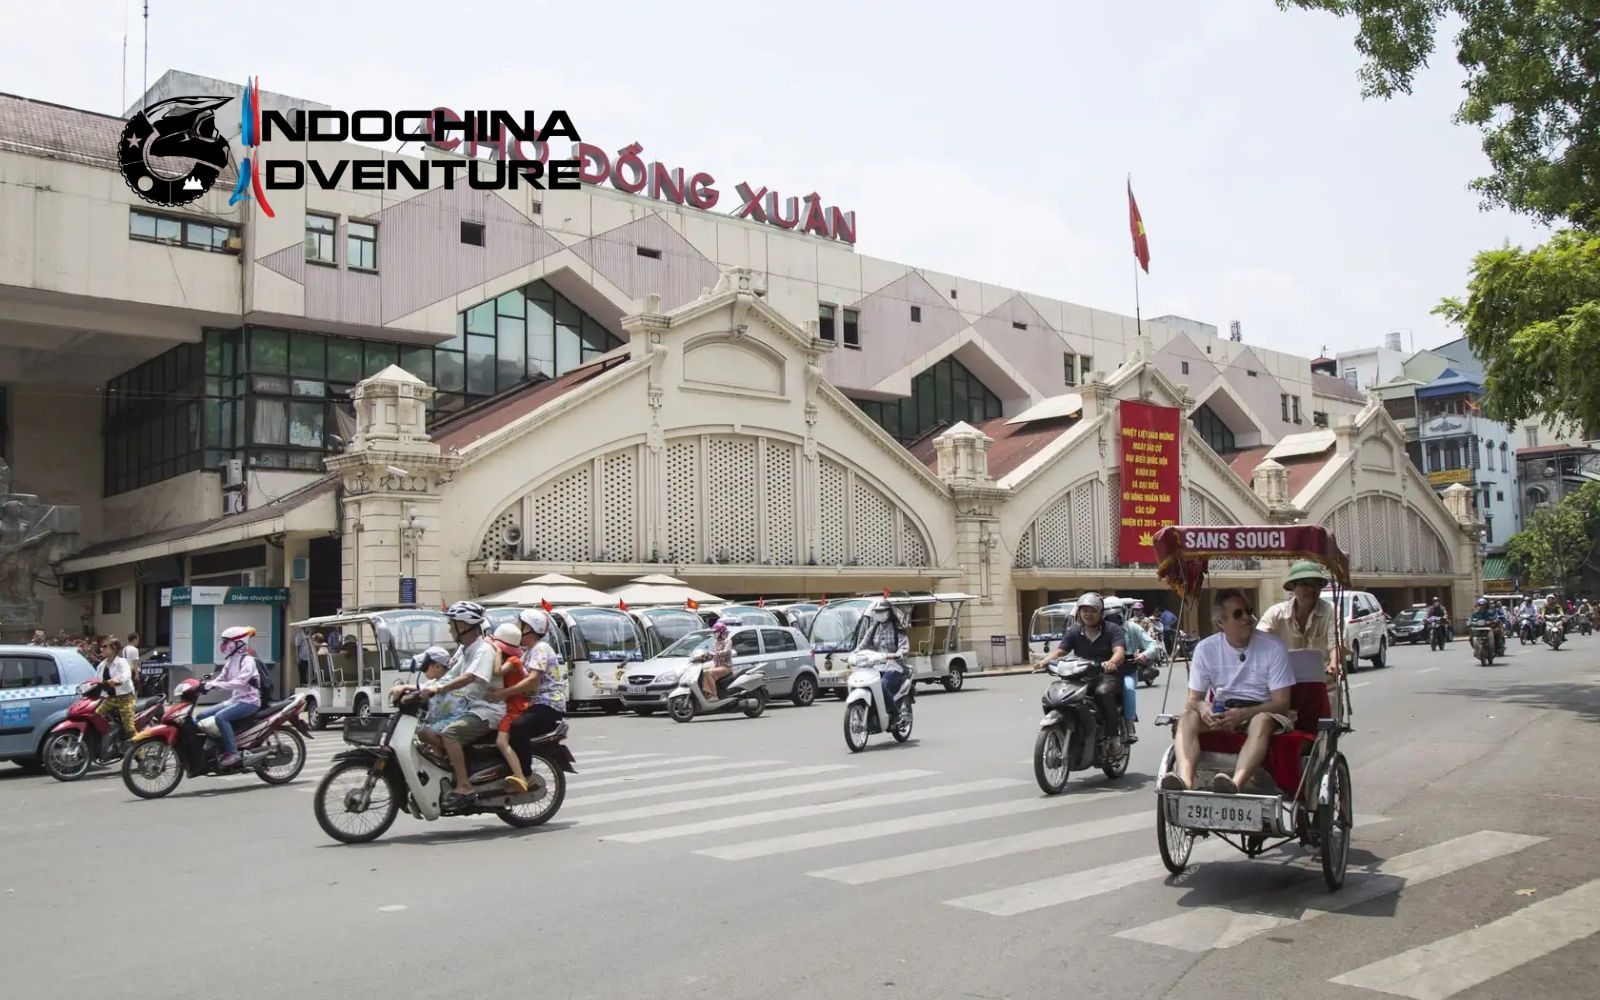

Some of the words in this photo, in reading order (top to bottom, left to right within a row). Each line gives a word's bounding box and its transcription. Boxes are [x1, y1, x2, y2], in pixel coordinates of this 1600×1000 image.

[735, 181, 856, 244] XUÂN
[1185, 532, 1230, 549] SANS
[1235, 531, 1285, 548] SOUCI
